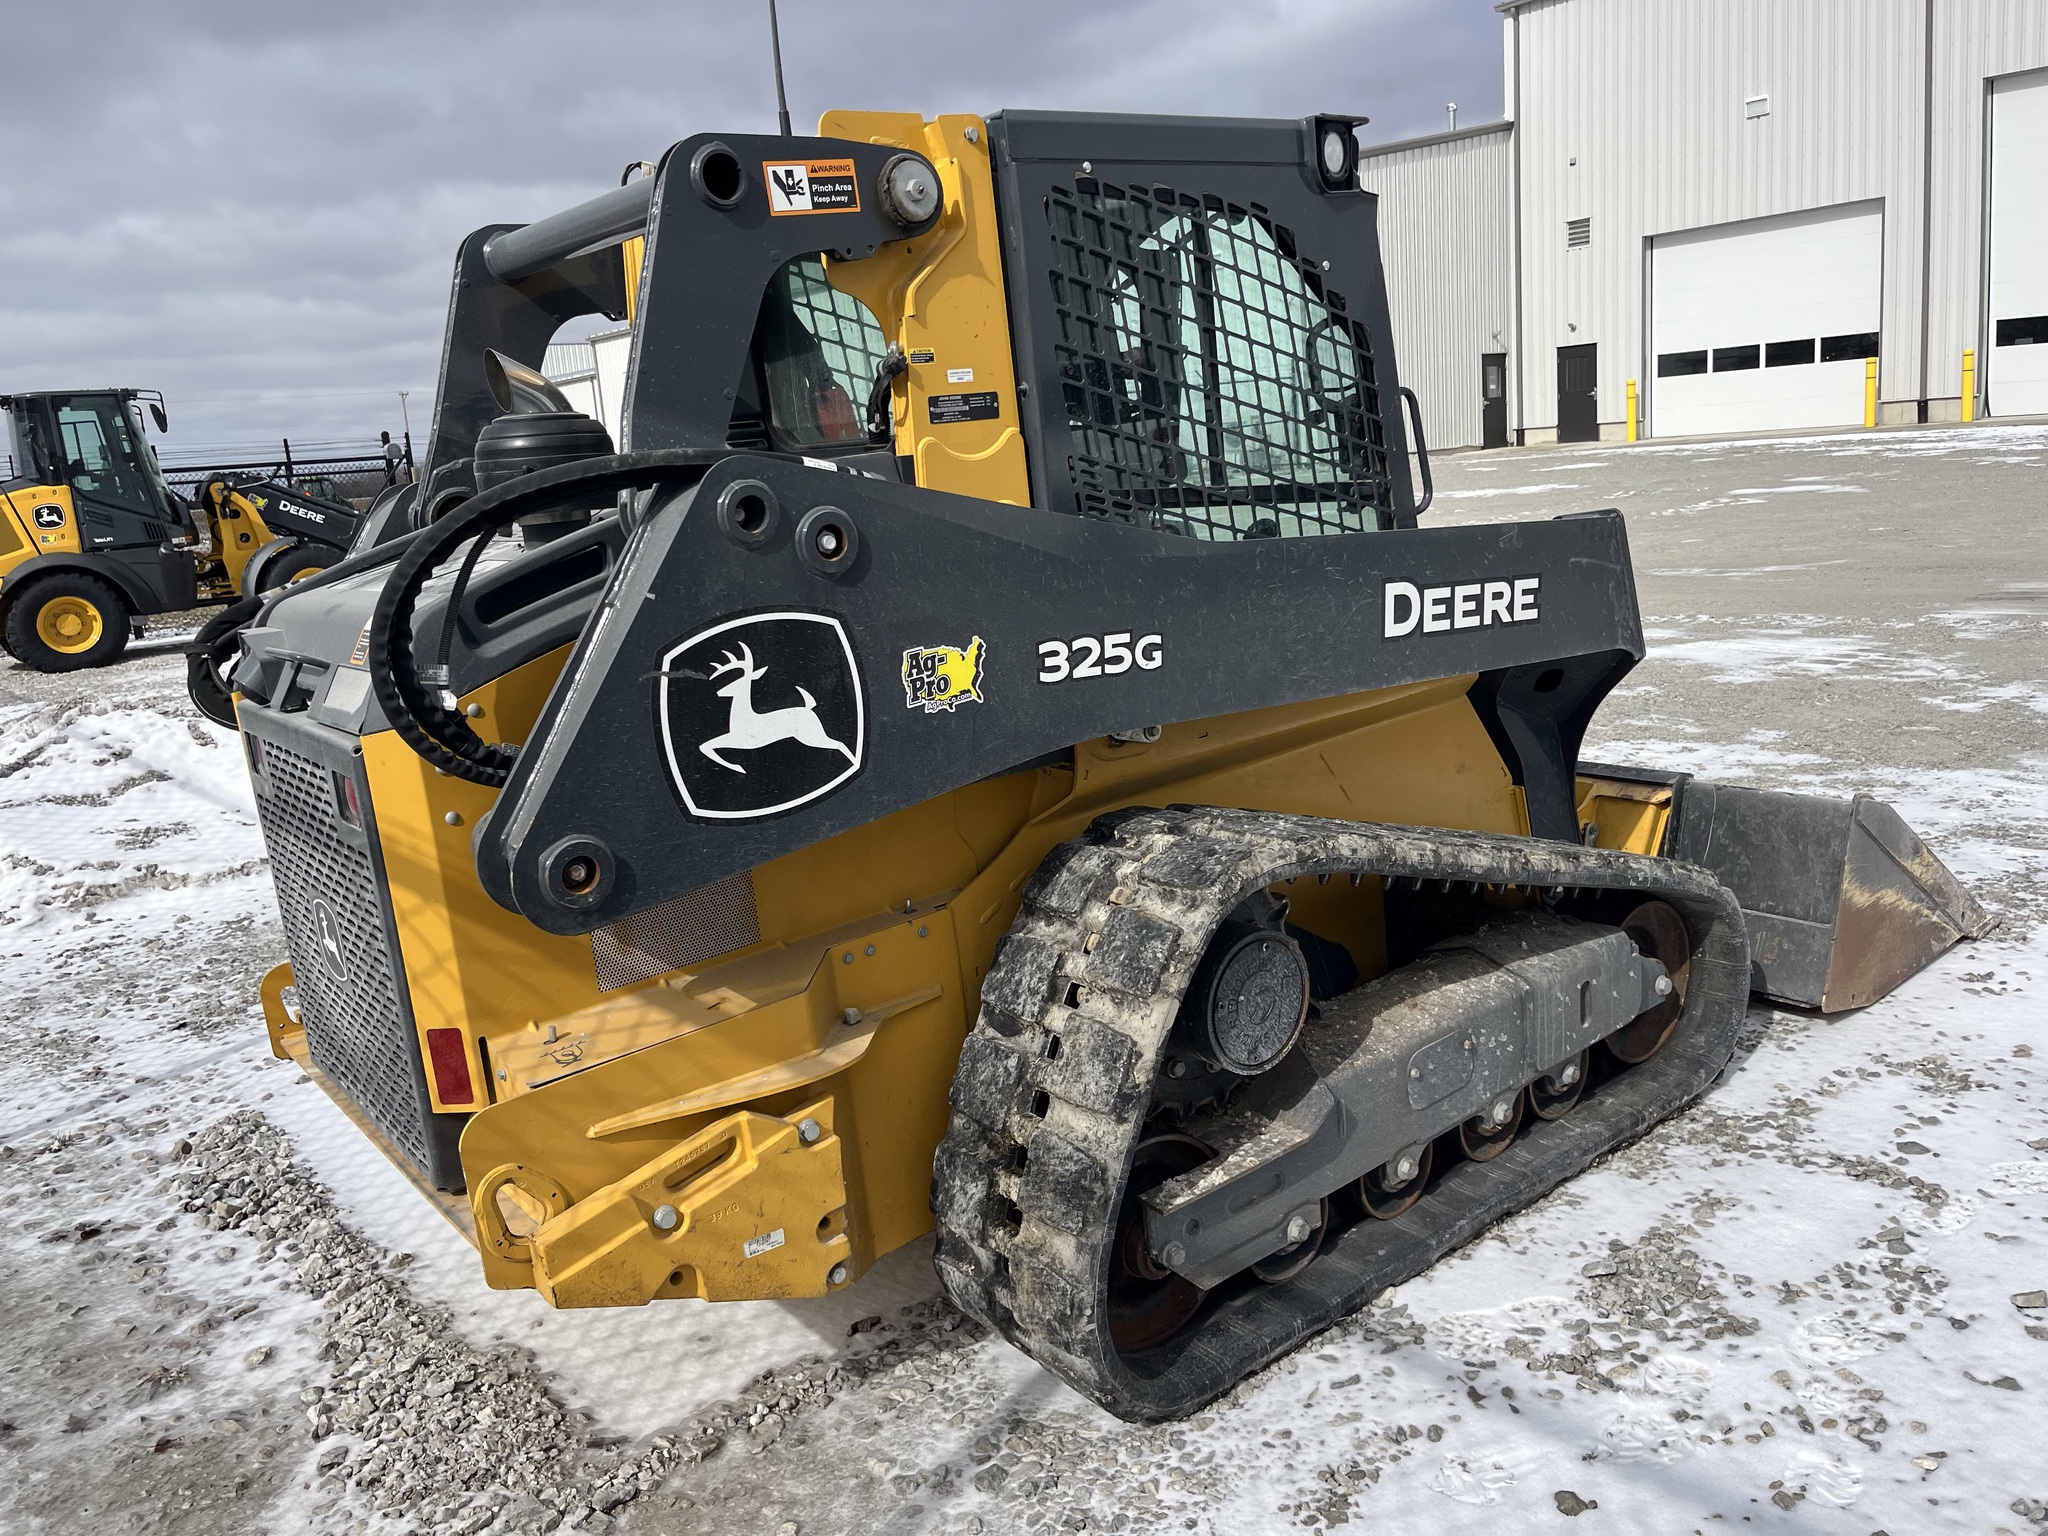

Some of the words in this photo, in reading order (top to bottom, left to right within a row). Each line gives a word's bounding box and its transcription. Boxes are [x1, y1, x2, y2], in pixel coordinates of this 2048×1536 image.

[817, 164, 851, 173] WARNING
[811, 183, 834, 193] Pinch
[835, 183, 852, 191] Area
[813, 195, 831, 204] Keep
[831, 195, 848, 203] Away
[279, 500, 326, 524] DEERE
[1384, 577, 1540, 638] DEERE
[906, 650, 946, 679] Ag-
[1038, 632, 1163, 683] 325G
[909, 675, 950, 704] Pro
[725, 1202, 740, 1215] KG
